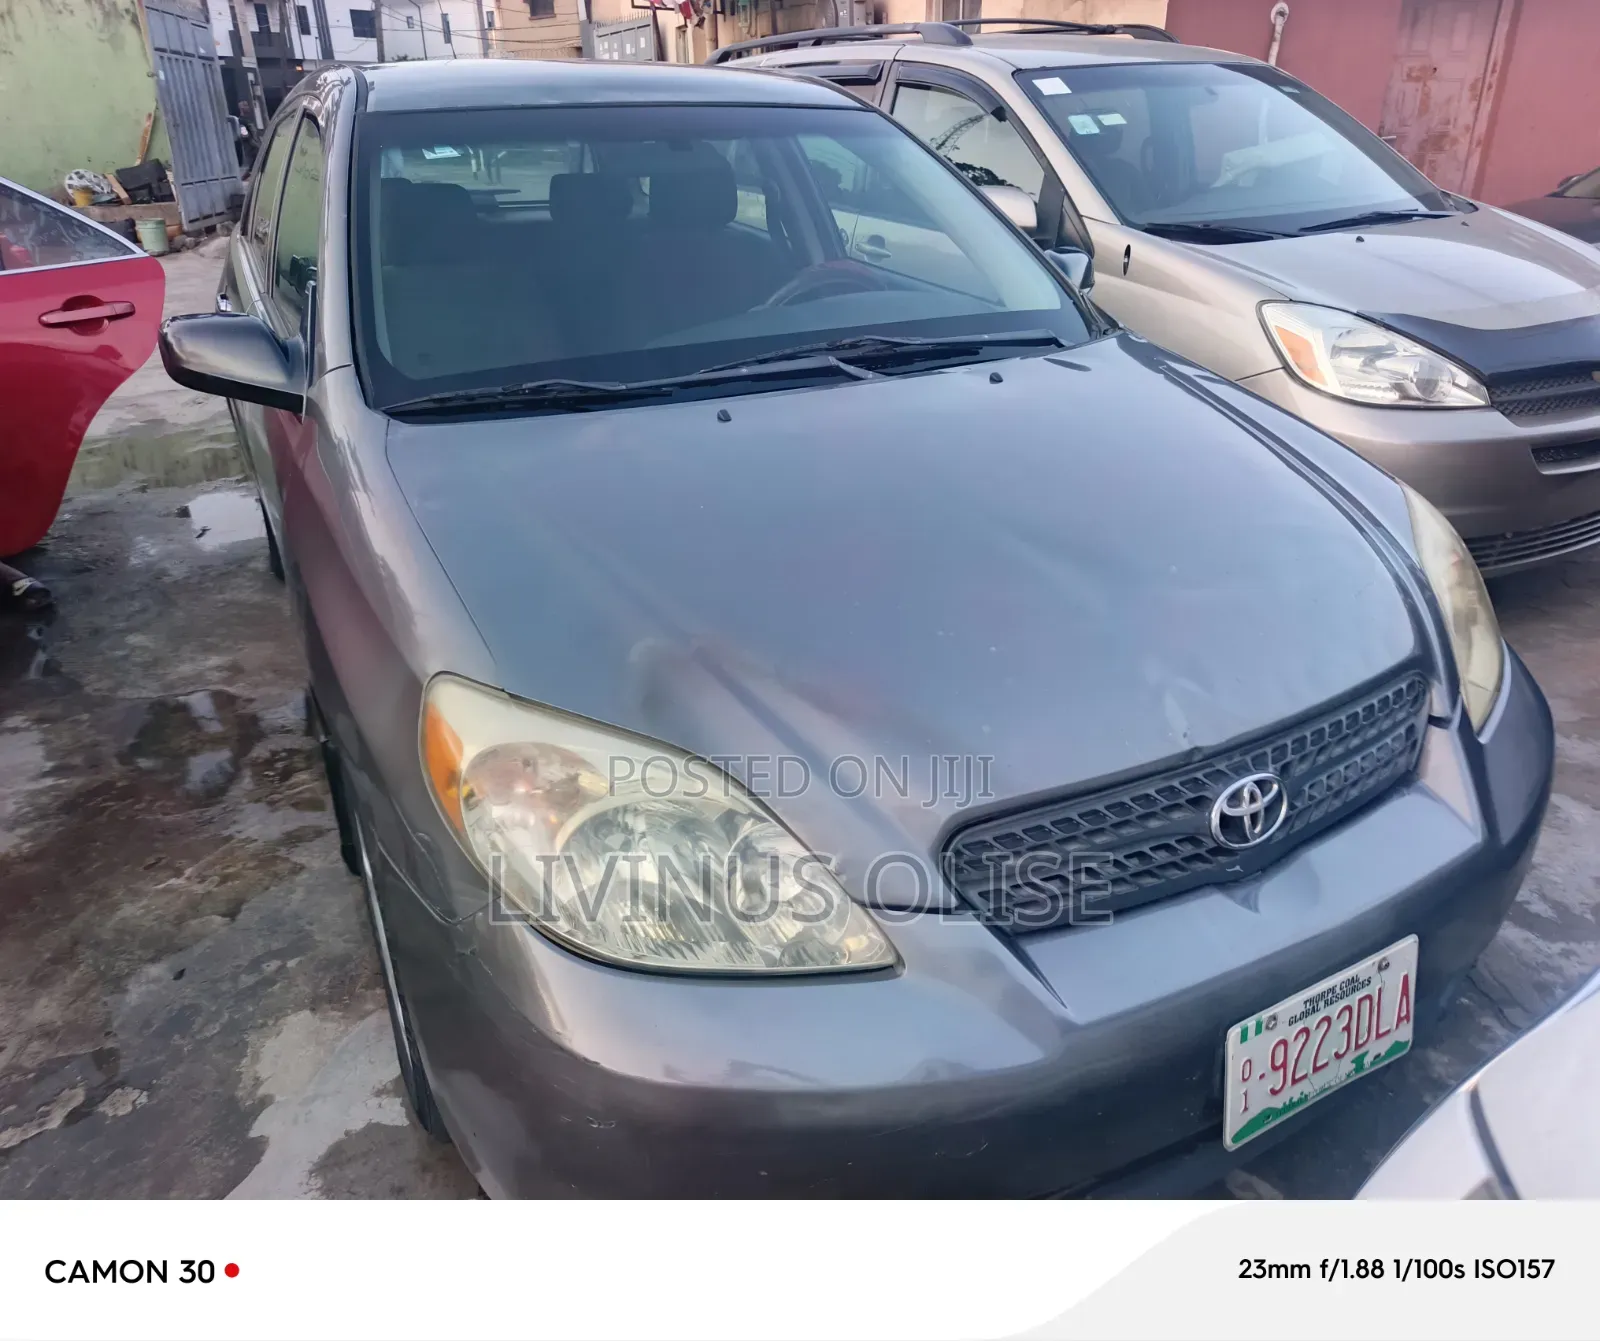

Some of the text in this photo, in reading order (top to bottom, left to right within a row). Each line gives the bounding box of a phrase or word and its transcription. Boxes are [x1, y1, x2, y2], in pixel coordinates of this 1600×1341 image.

[1288, 976, 1372, 1027] GLOBAL RESOURCES
[1303, 974, 1360, 1009] THORPE COAL
